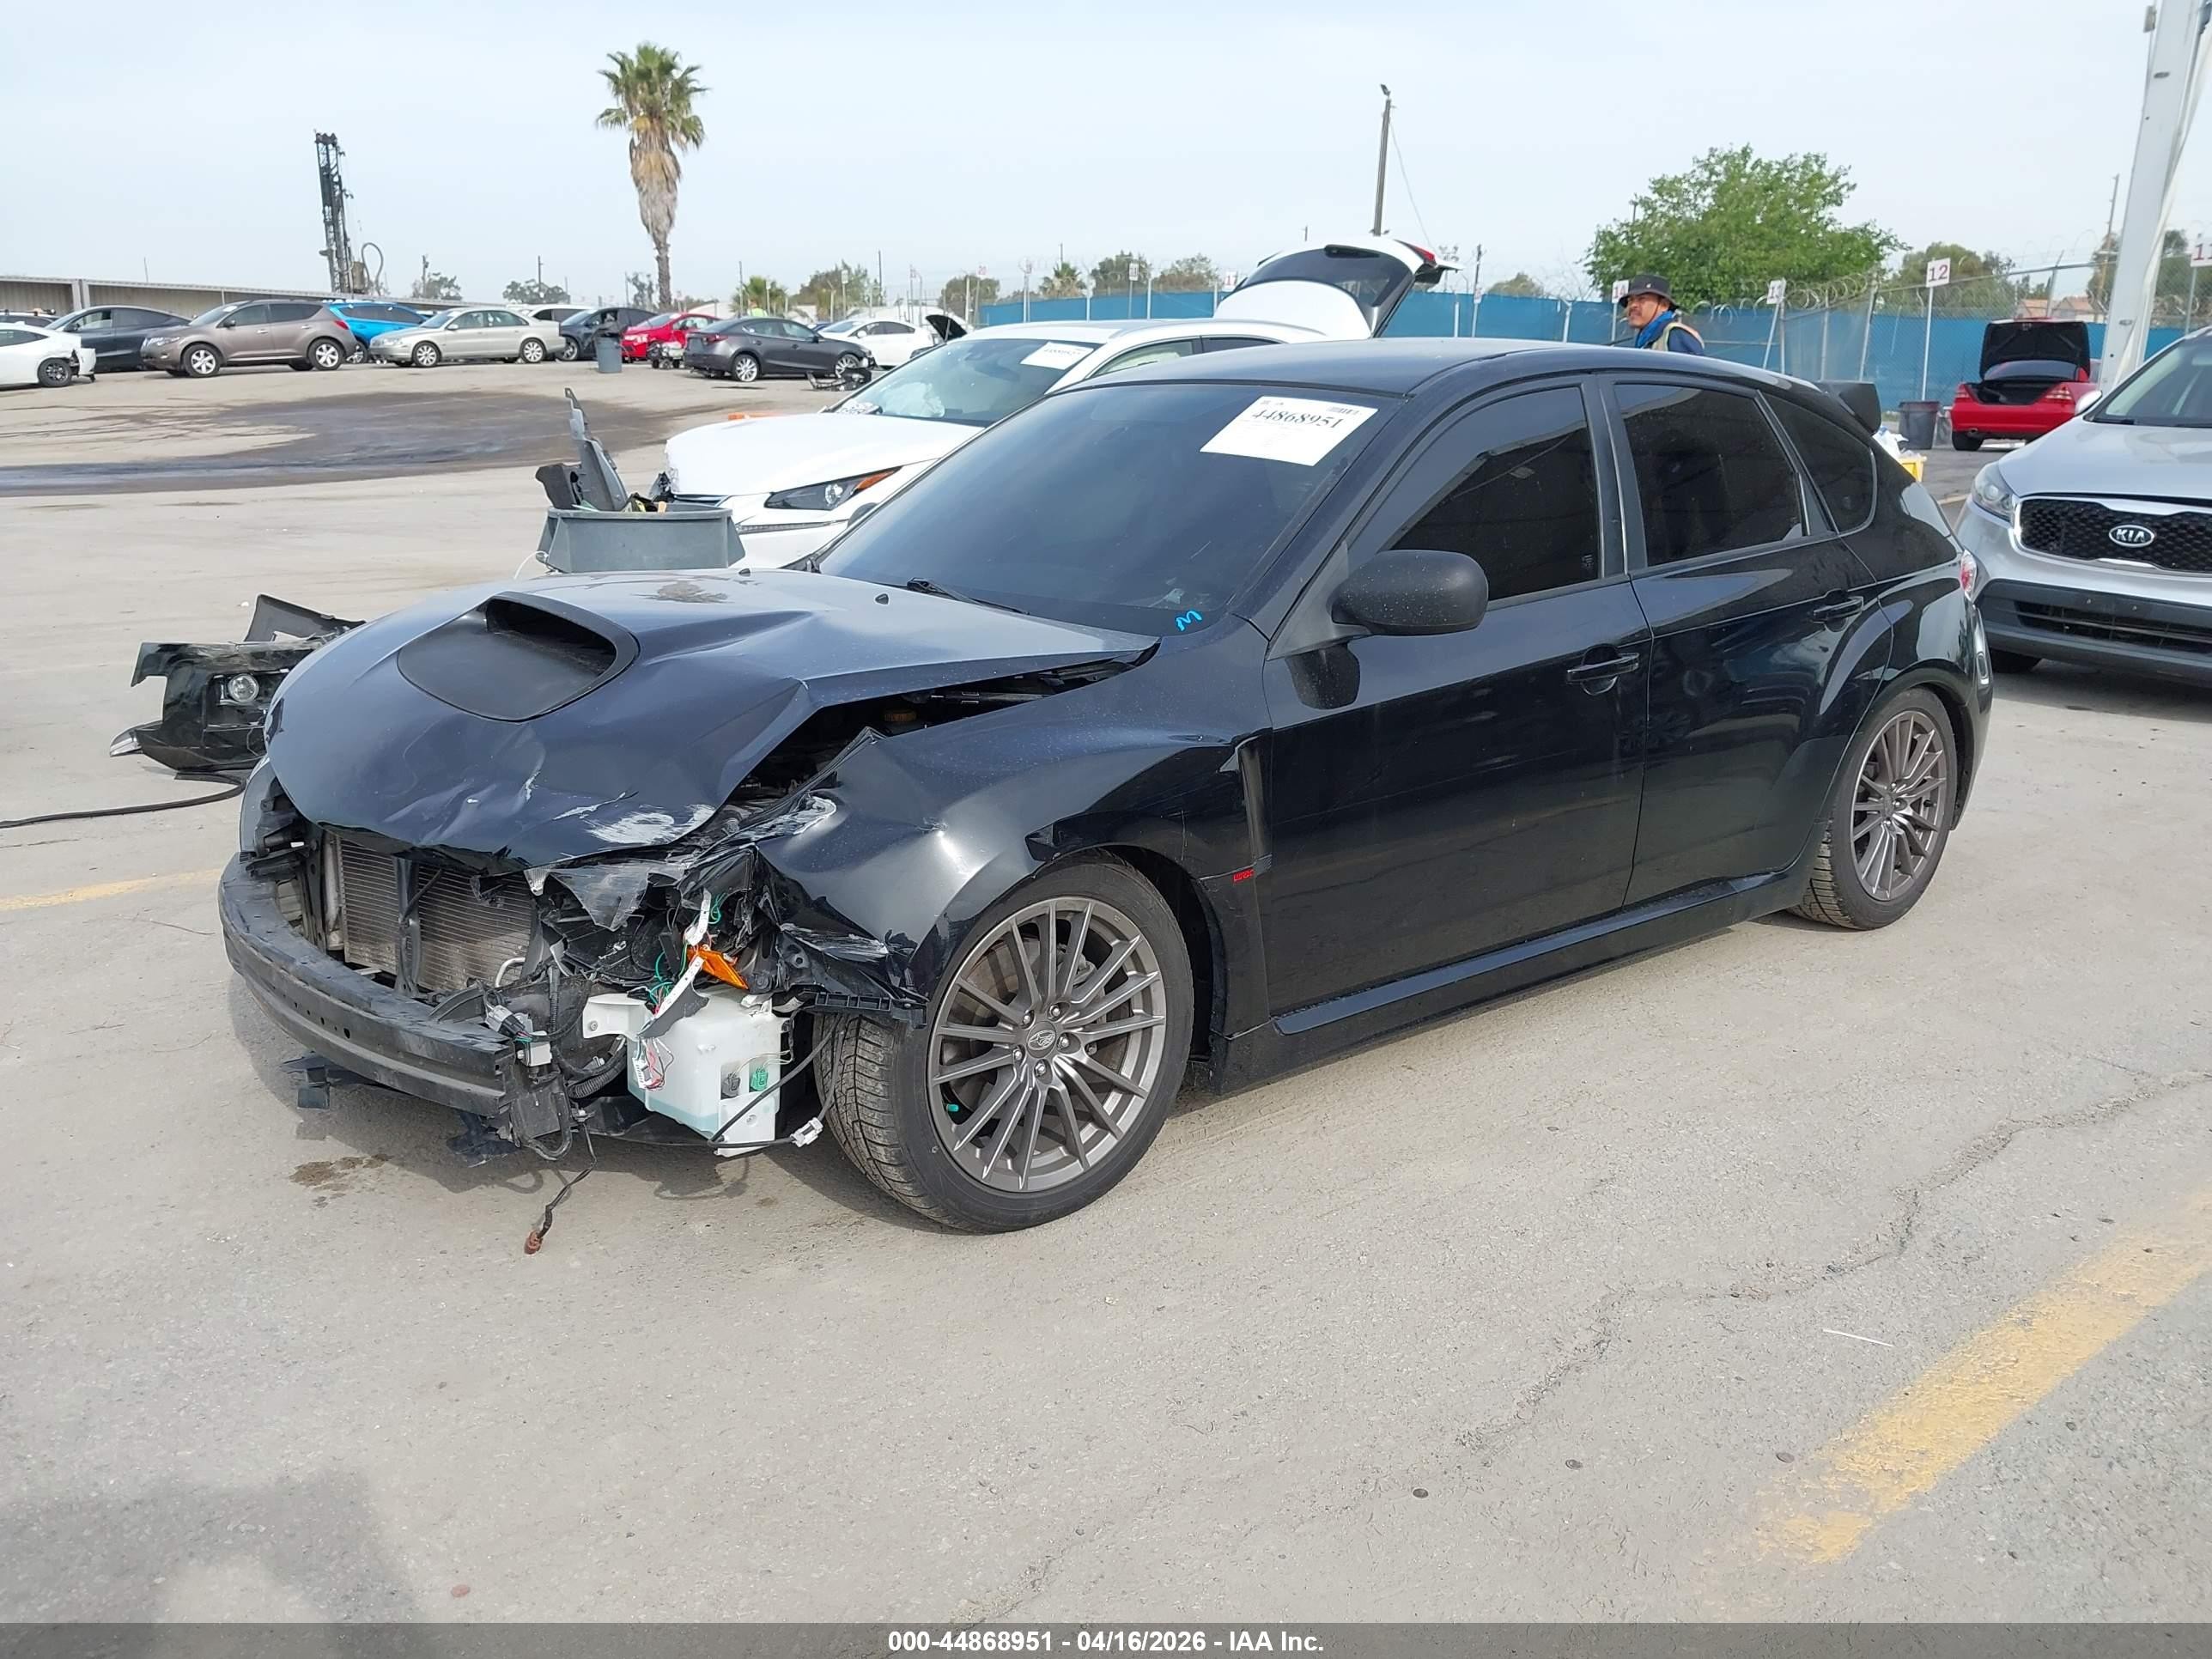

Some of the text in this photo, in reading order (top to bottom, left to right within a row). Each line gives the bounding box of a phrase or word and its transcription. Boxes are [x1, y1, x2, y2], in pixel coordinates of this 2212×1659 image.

[1928, 264, 1948, 283] 12
[1252, 410, 1344, 428] 44868951
[2116, 528, 2146, 543] KIA
